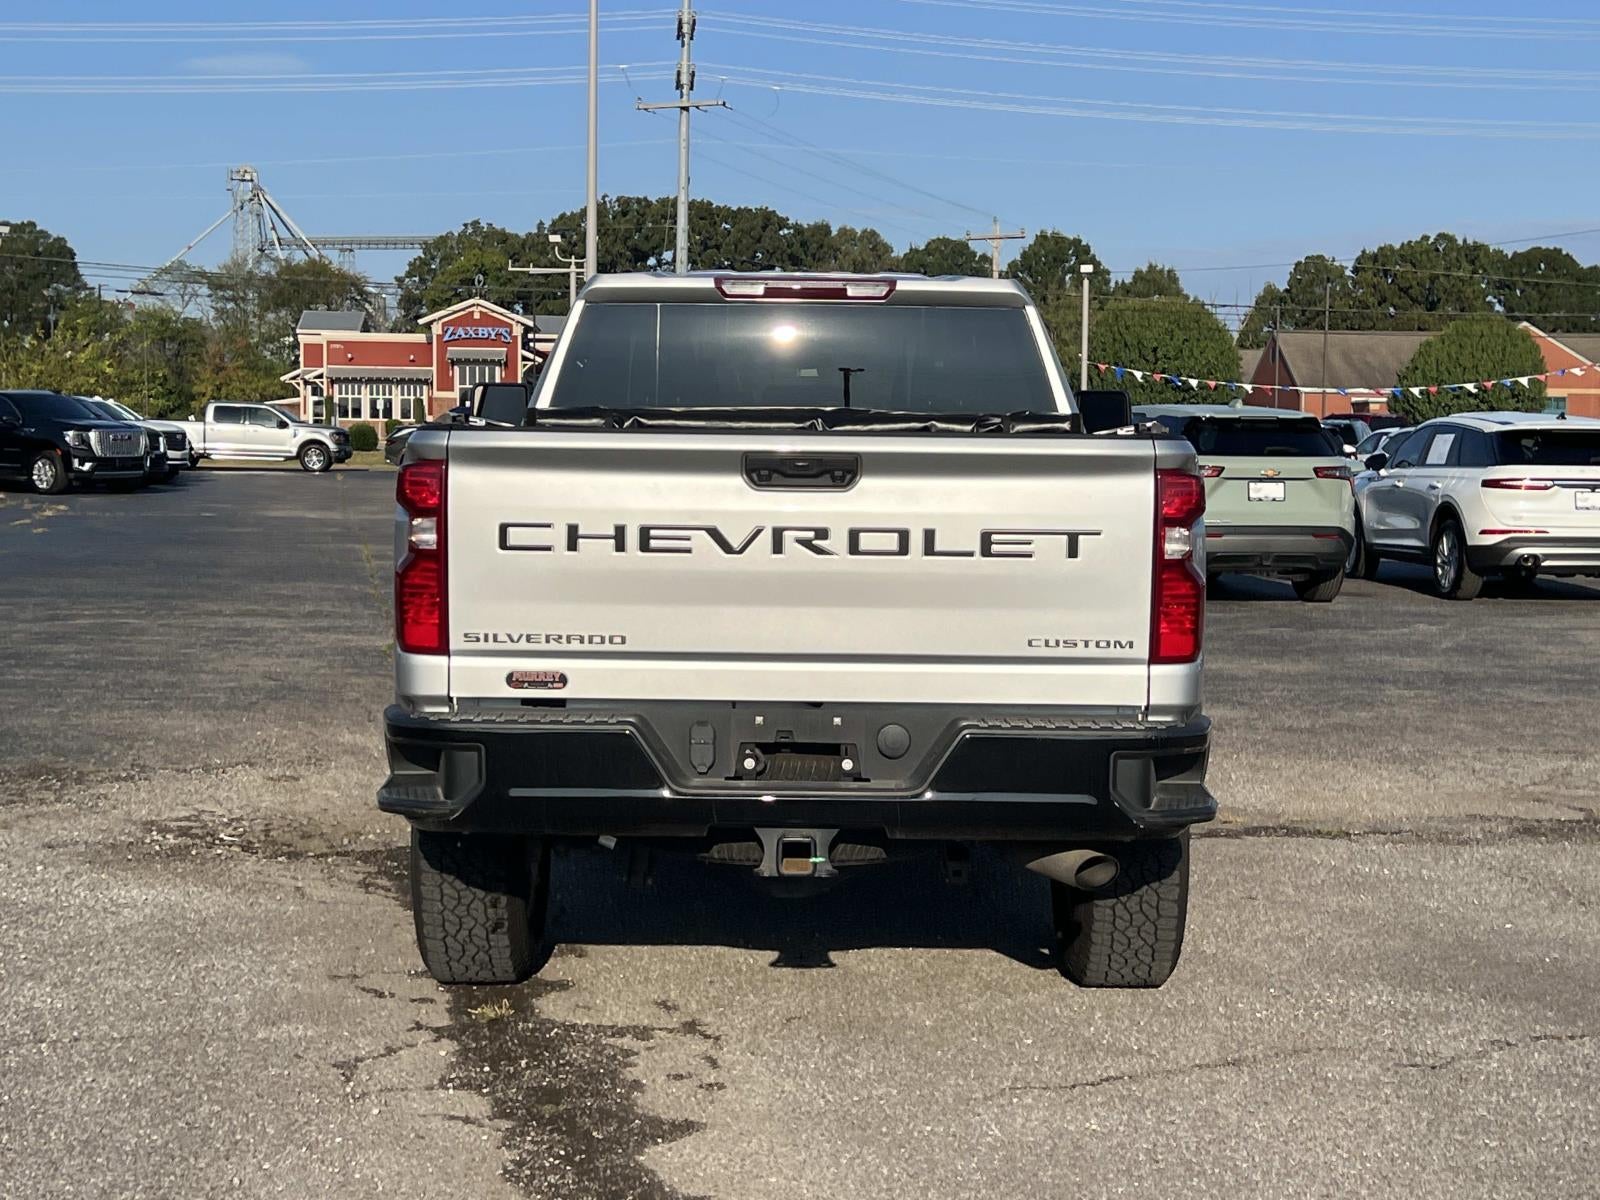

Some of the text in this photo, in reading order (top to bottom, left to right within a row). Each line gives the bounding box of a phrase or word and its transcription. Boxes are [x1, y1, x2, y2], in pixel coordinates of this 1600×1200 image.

[443, 326, 512, 343] ZAXBY'S
[499, 522, 1102, 559] CHEVROLET
[463, 632, 627, 645] SILVERADO
[1027, 638, 1134, 649] CUSTOM
